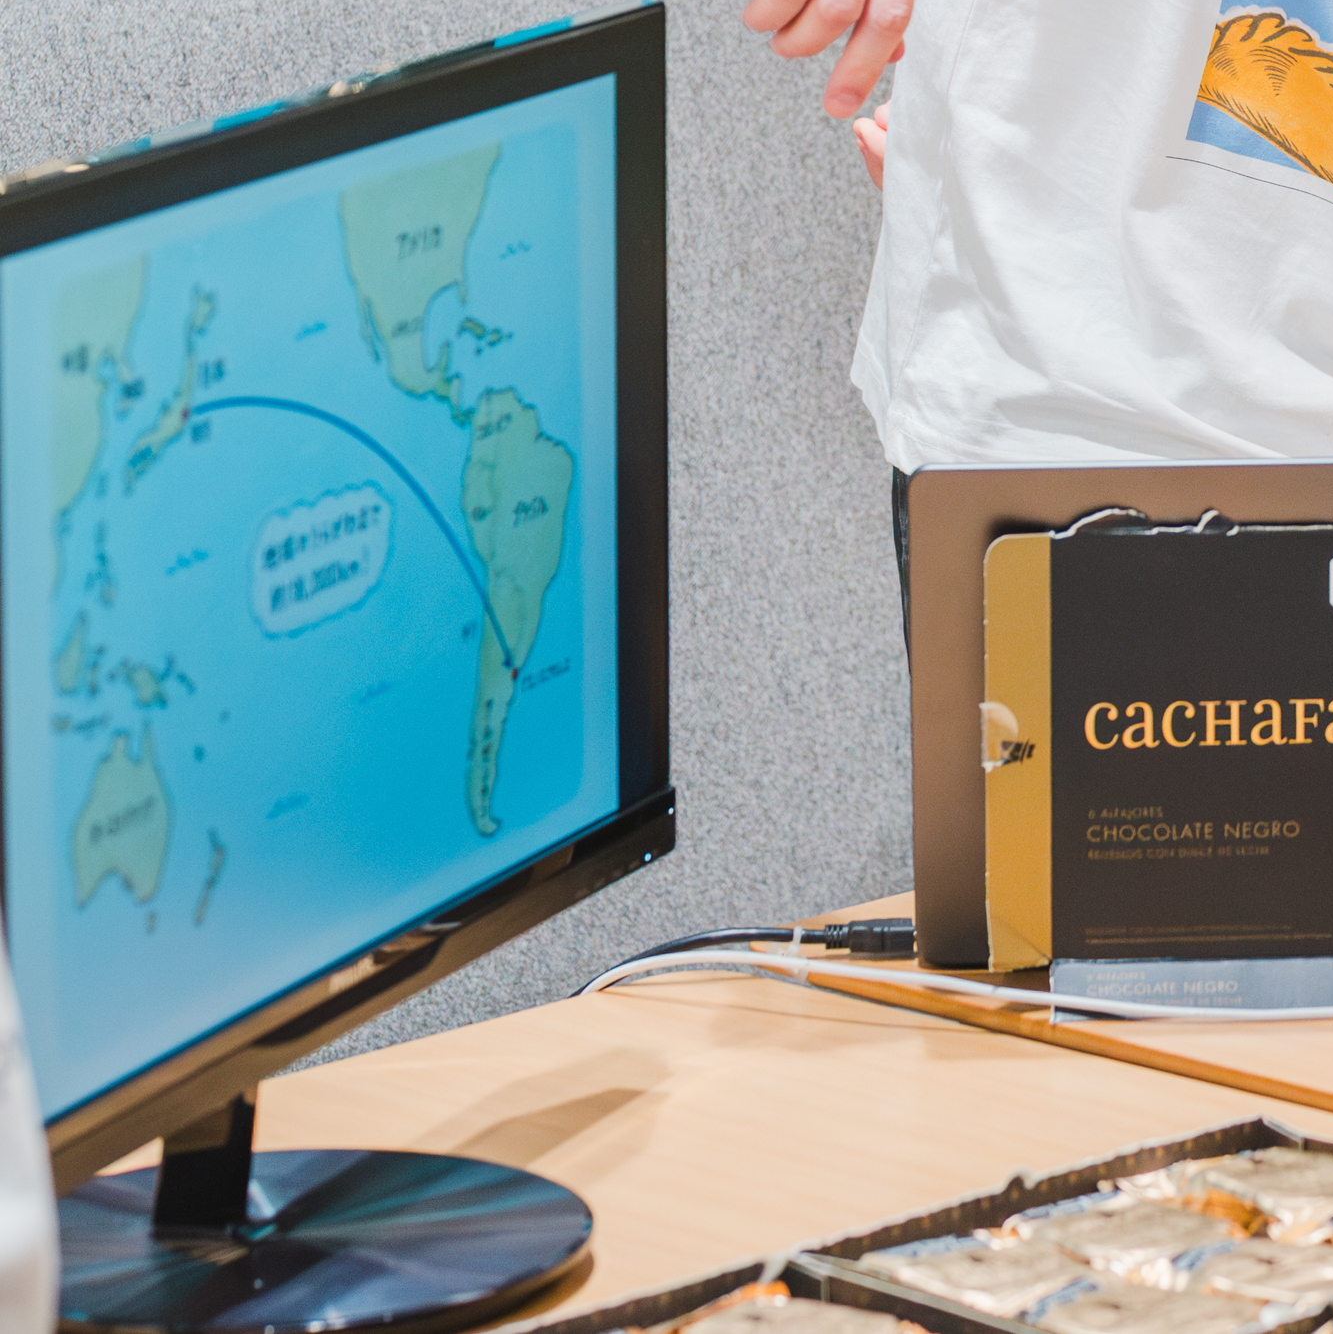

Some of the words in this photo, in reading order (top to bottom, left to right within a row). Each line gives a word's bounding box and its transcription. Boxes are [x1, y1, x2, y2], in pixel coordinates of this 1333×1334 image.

[1086, 822, 1214, 843] CHOCOLATE
[1224, 819, 1300, 840] NEGRO
[1086, 982, 1178, 997] CHOCOLATE
[1183, 979, 1240, 995] NEGRO
